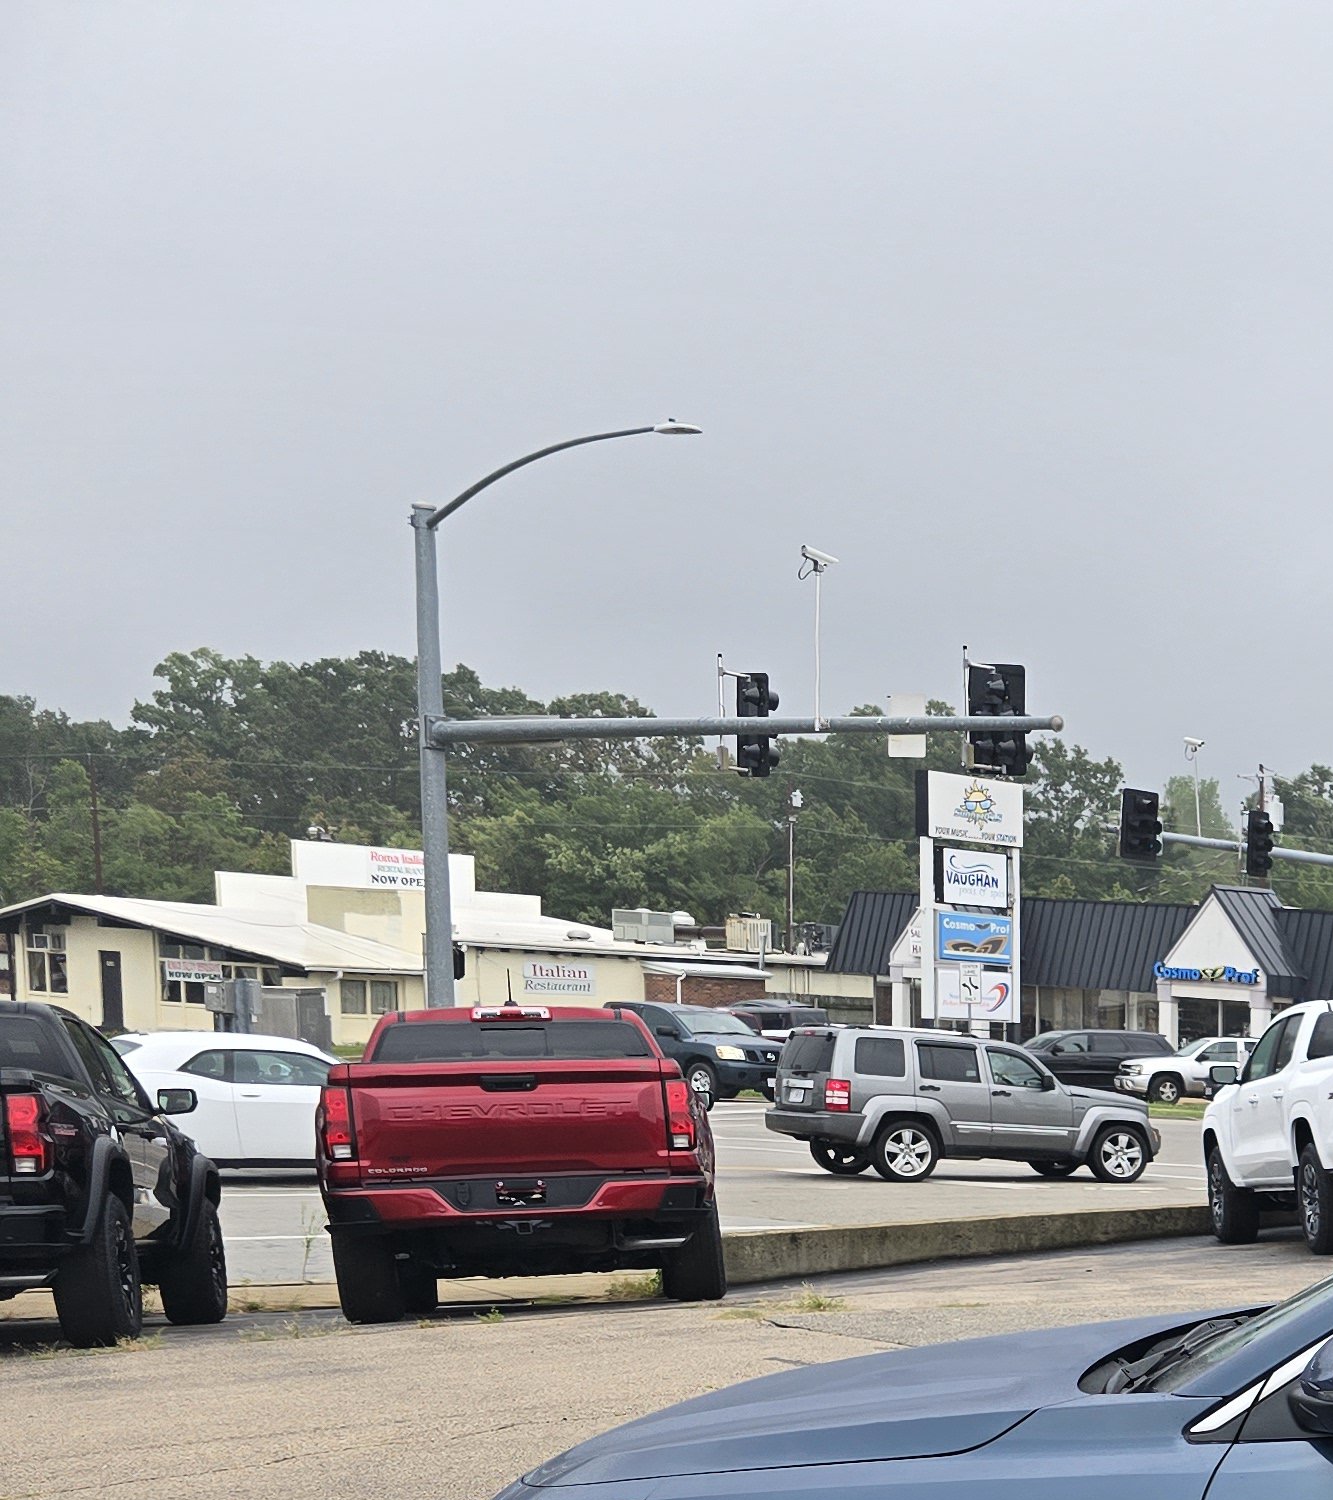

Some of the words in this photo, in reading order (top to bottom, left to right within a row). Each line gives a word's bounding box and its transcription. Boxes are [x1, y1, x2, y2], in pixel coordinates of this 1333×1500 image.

[371, 874, 399, 884] NOW
[401, 877, 426, 887] OPE
[946, 870, 999, 888] VAUGHAN
[943, 918, 976, 931] Cosmo
[168, 970, 192, 978] NOW
[532, 963, 588, 978] Italian
[1154, 961, 1201, 981] Cosmo
[1224, 966, 1259, 984] Prof
[524, 979, 591, 992] Restaurant
[387, 1100, 632, 1122] CHEVROLET
[367, 1166, 428, 1174] COLORADO
